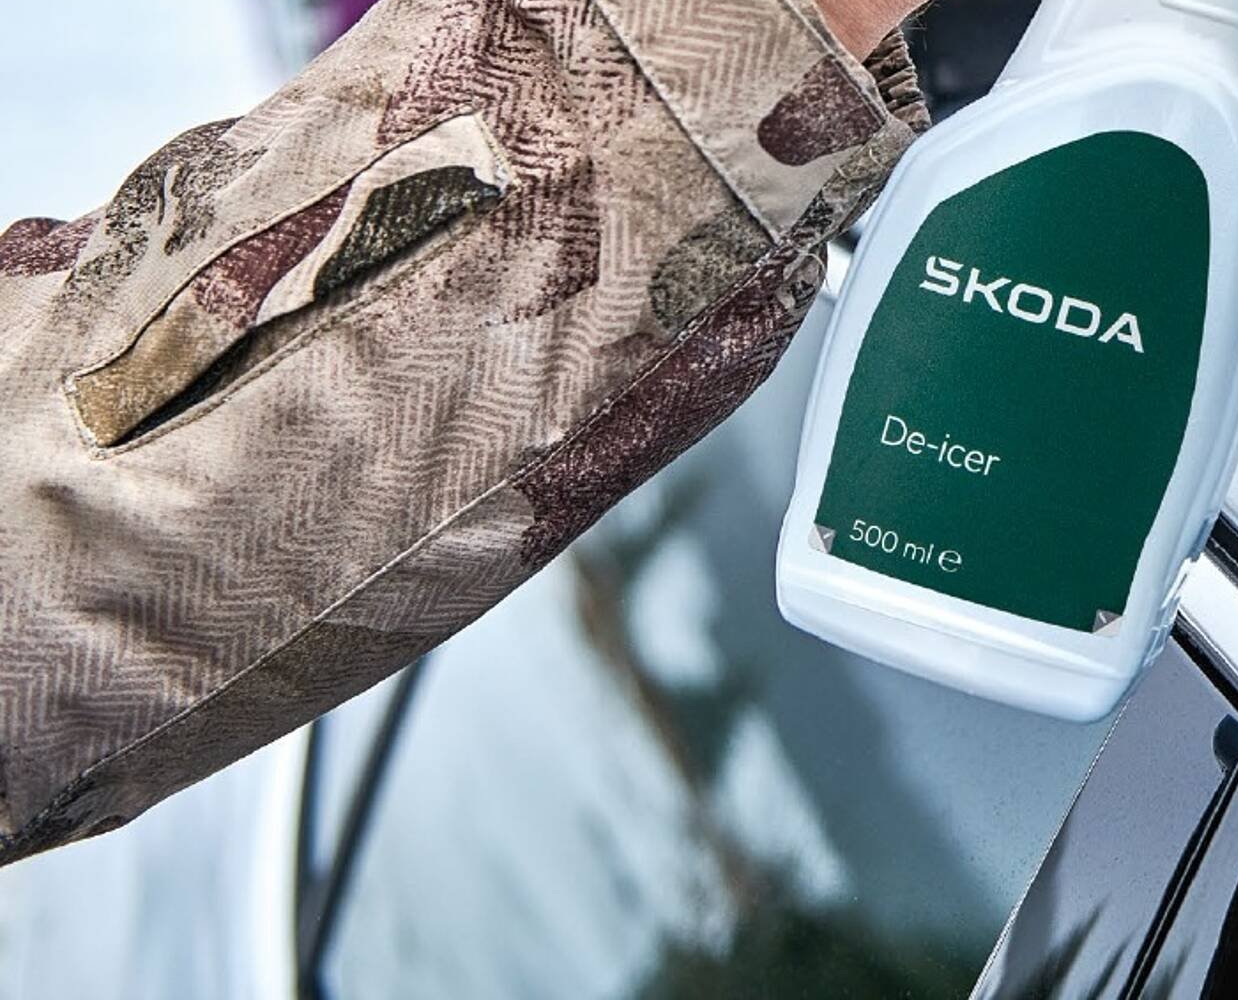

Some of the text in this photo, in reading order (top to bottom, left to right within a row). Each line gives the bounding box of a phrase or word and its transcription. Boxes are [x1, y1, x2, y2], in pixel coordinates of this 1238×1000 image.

[919, 255, 1144, 353] SKODA
[880, 414, 1001, 477] De-icer
[849, 519, 899, 553] 500
[902, 542, 934, 565] ml
